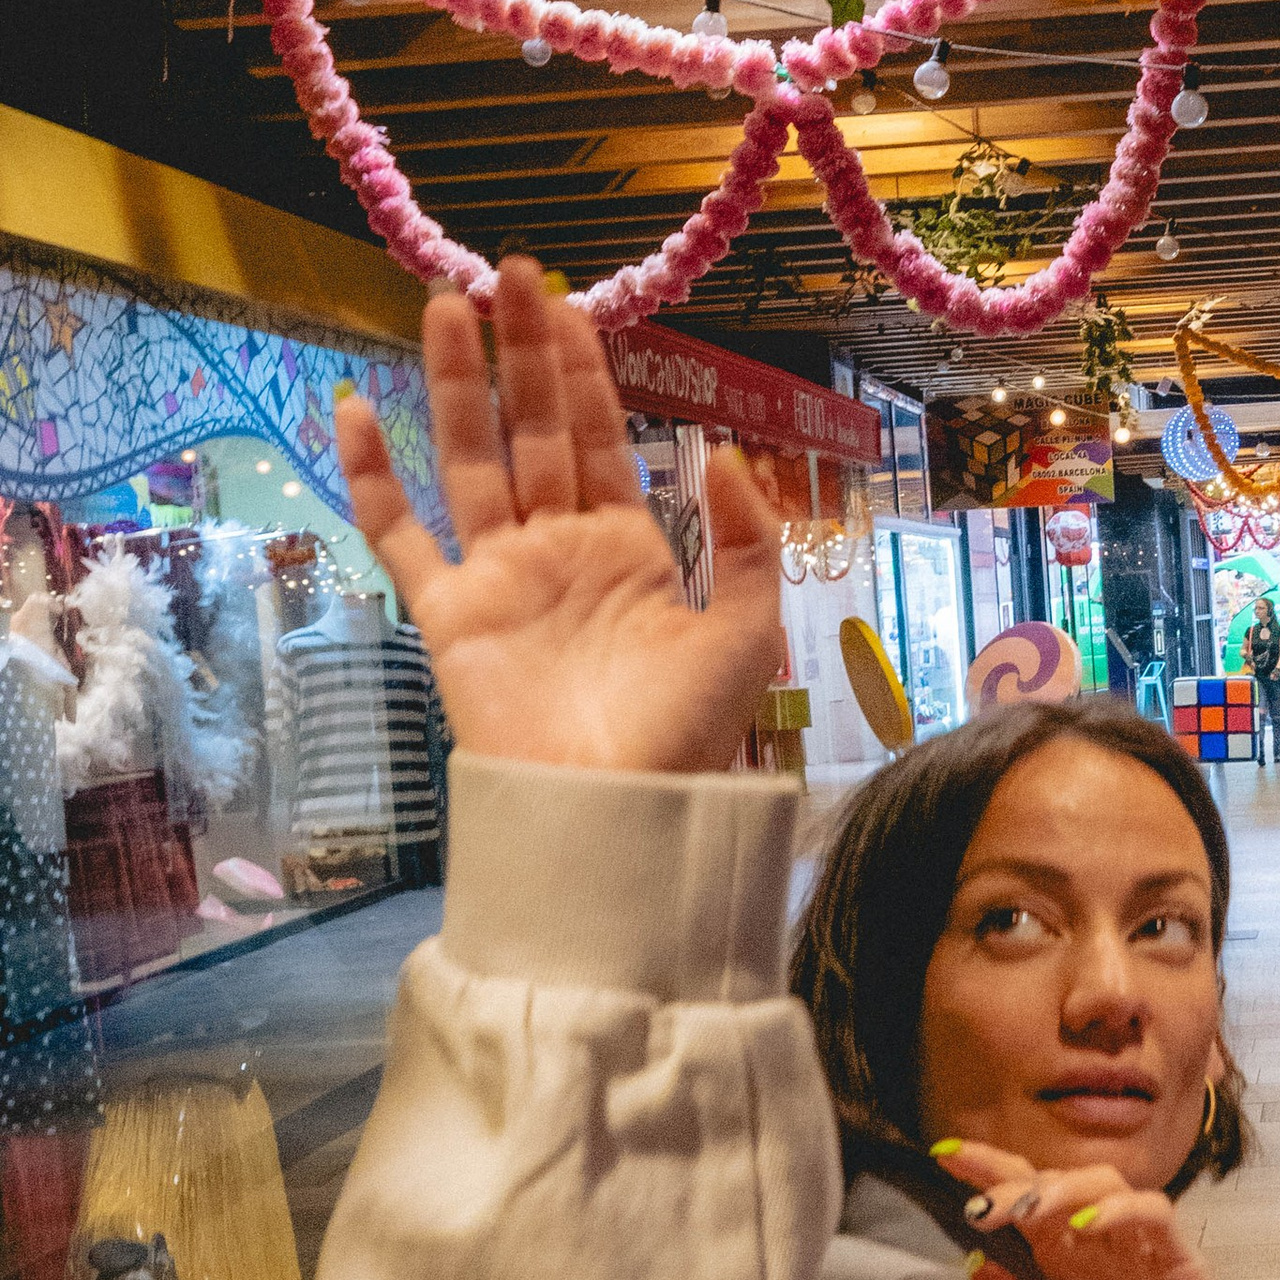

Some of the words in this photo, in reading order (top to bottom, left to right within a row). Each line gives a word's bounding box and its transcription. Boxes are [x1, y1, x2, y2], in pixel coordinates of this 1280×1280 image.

[1064, 393, 1102, 406] CUBE
[1034, 436, 1060, 445] CALLE
[1049, 452, 1075, 461] LOCAL
[1032, 470, 1056, 478] 08002
[1058, 468, 1107, 477] BARCELONA
[1058, 485, 1083, 494] SPAIN
